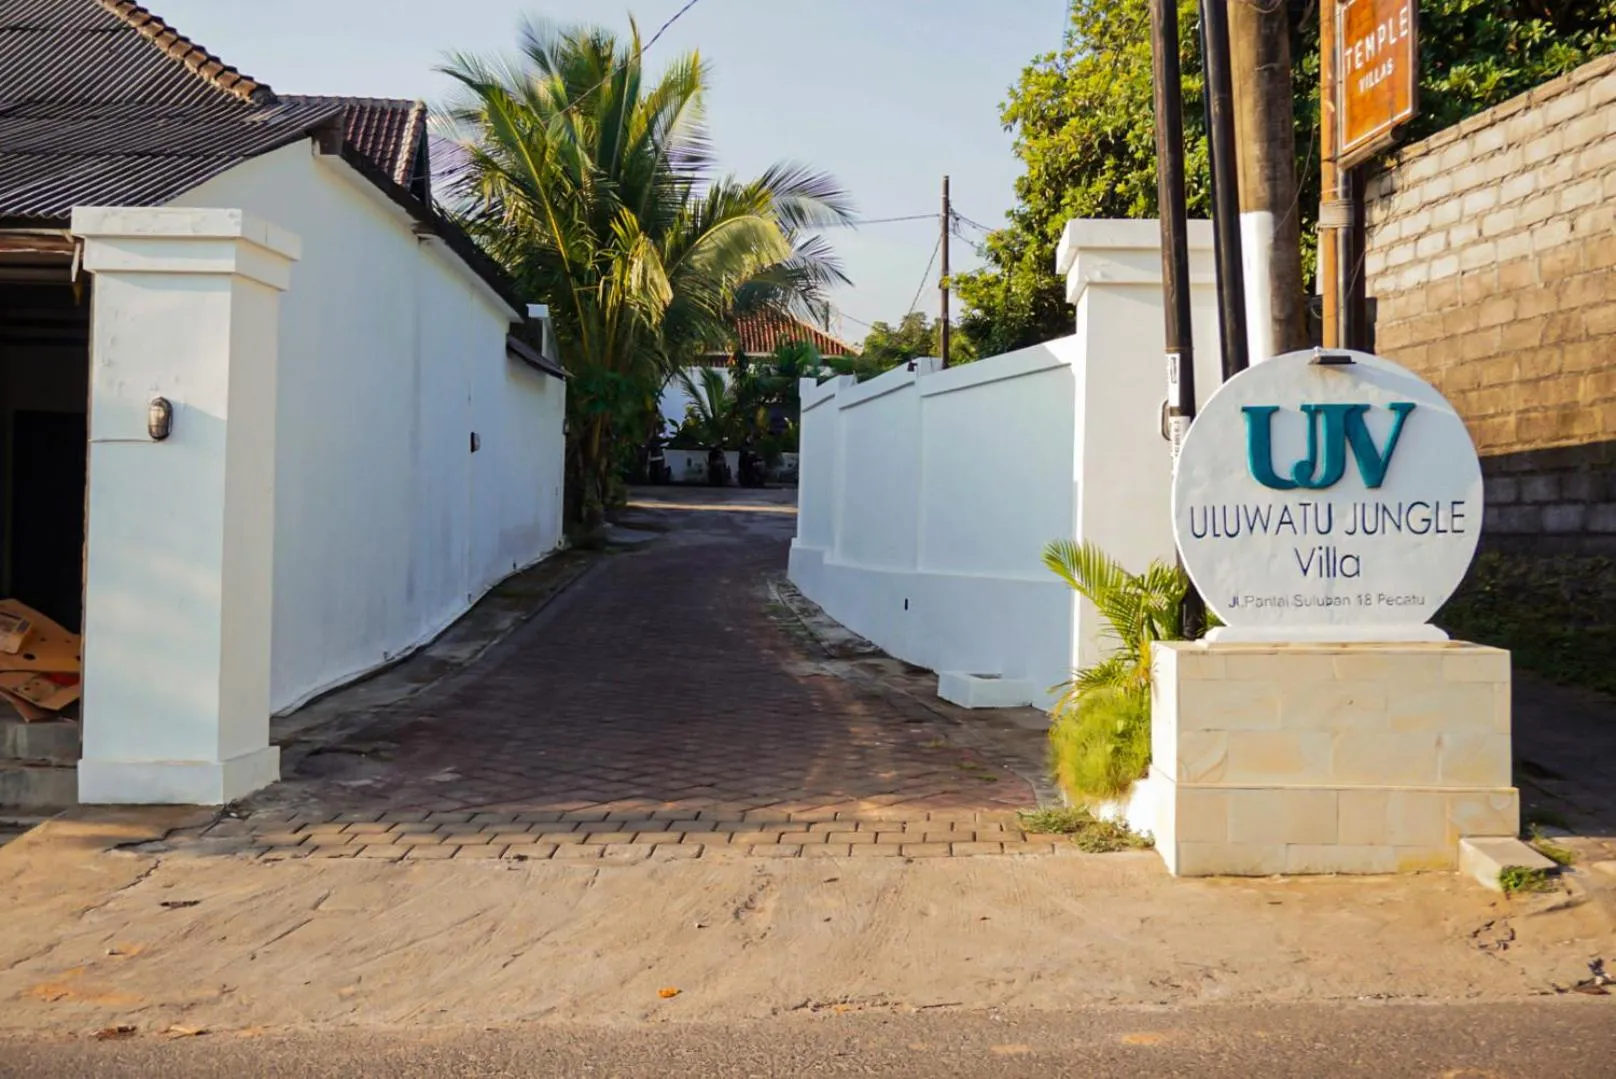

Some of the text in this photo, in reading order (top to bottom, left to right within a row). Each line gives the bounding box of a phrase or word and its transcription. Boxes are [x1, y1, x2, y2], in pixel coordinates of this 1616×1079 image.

[1344, 6, 1408, 74] TEMPLE
[1358, 57, 1394, 93] VILLAS
[1241, 402, 1417, 490] UJV
[1190, 501, 1465, 539] ULUWATU JUNGLE
[1294, 546, 1361, 579] Villa
[1357, 592, 1373, 606] 18
[1378, 592, 1425, 606] Pecatu
